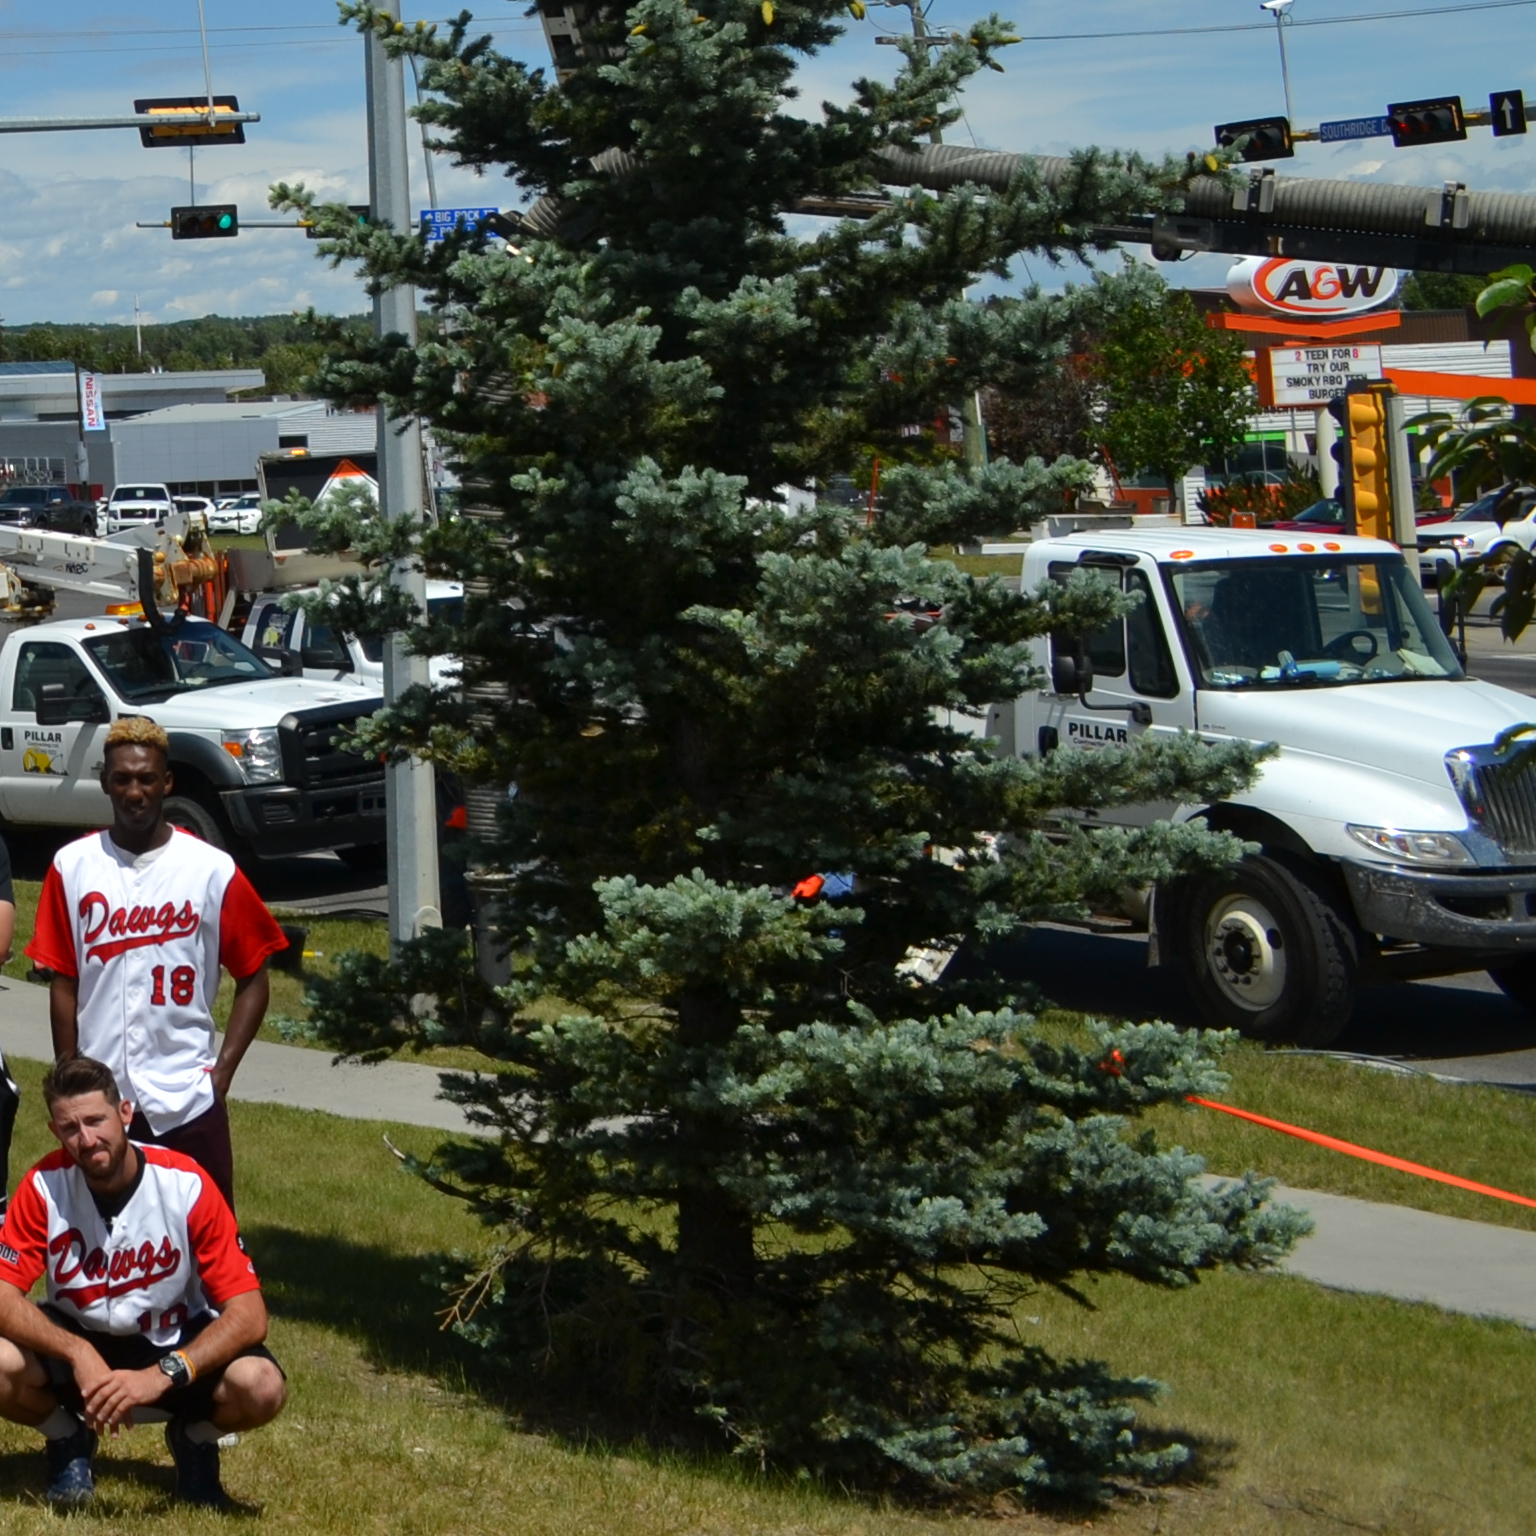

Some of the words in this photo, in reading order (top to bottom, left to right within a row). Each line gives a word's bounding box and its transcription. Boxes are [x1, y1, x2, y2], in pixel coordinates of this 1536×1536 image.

[1322, 120, 1378, 139] SOUTHRIDGE
[435, 211, 451, 222] BIG
[1274, 265, 1385, 300] A&W
[1294, 350, 1302, 362] 2
[1304, 350, 1329, 360] TEEN
[1332, 348, 1351, 359] FOR
[1306, 363, 1326, 373] TRY
[1330, 362, 1350, 373] OUR
[1286, 376, 1321, 388] SMOKY
[85, 376, 97, 428] NISSAN
[24, 730, 62, 743] PILLAR
[1068, 722, 1128, 743] PILLAR
[79, 891, 200, 946] Dawgs
[150, 964, 196, 1006] 18
[49, 1227, 181, 1287] Dawgs
